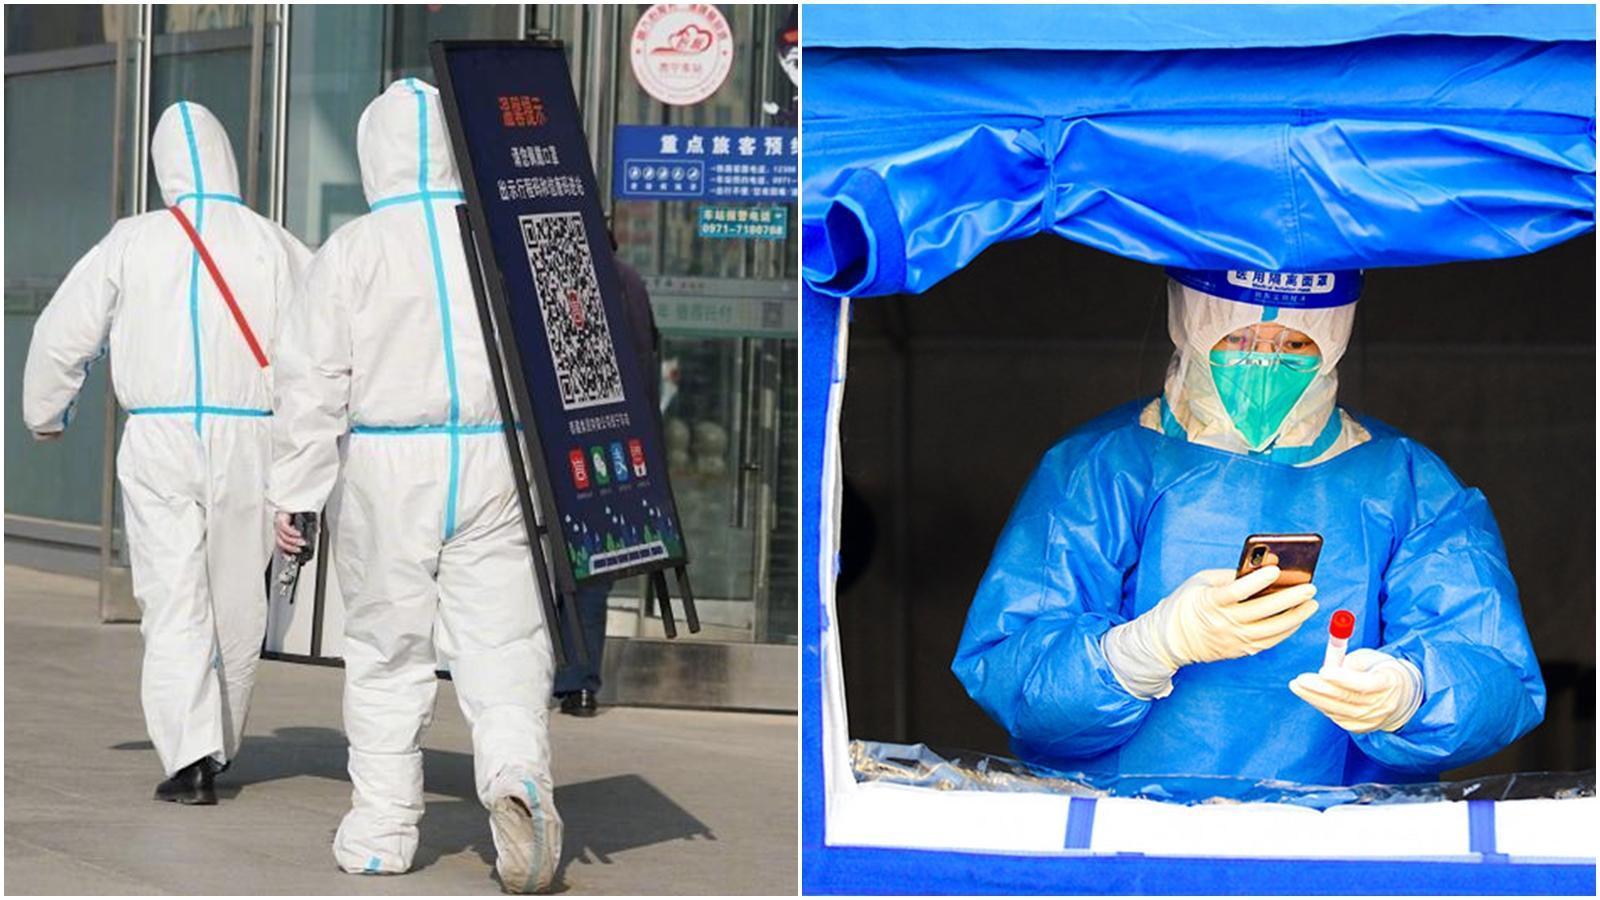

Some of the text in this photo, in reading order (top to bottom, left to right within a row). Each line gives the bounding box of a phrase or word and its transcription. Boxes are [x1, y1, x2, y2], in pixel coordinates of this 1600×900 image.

[498, 95, 546, 128] 温馨提示
[1236, 270, 1328, 287] 医用隔离面罩
